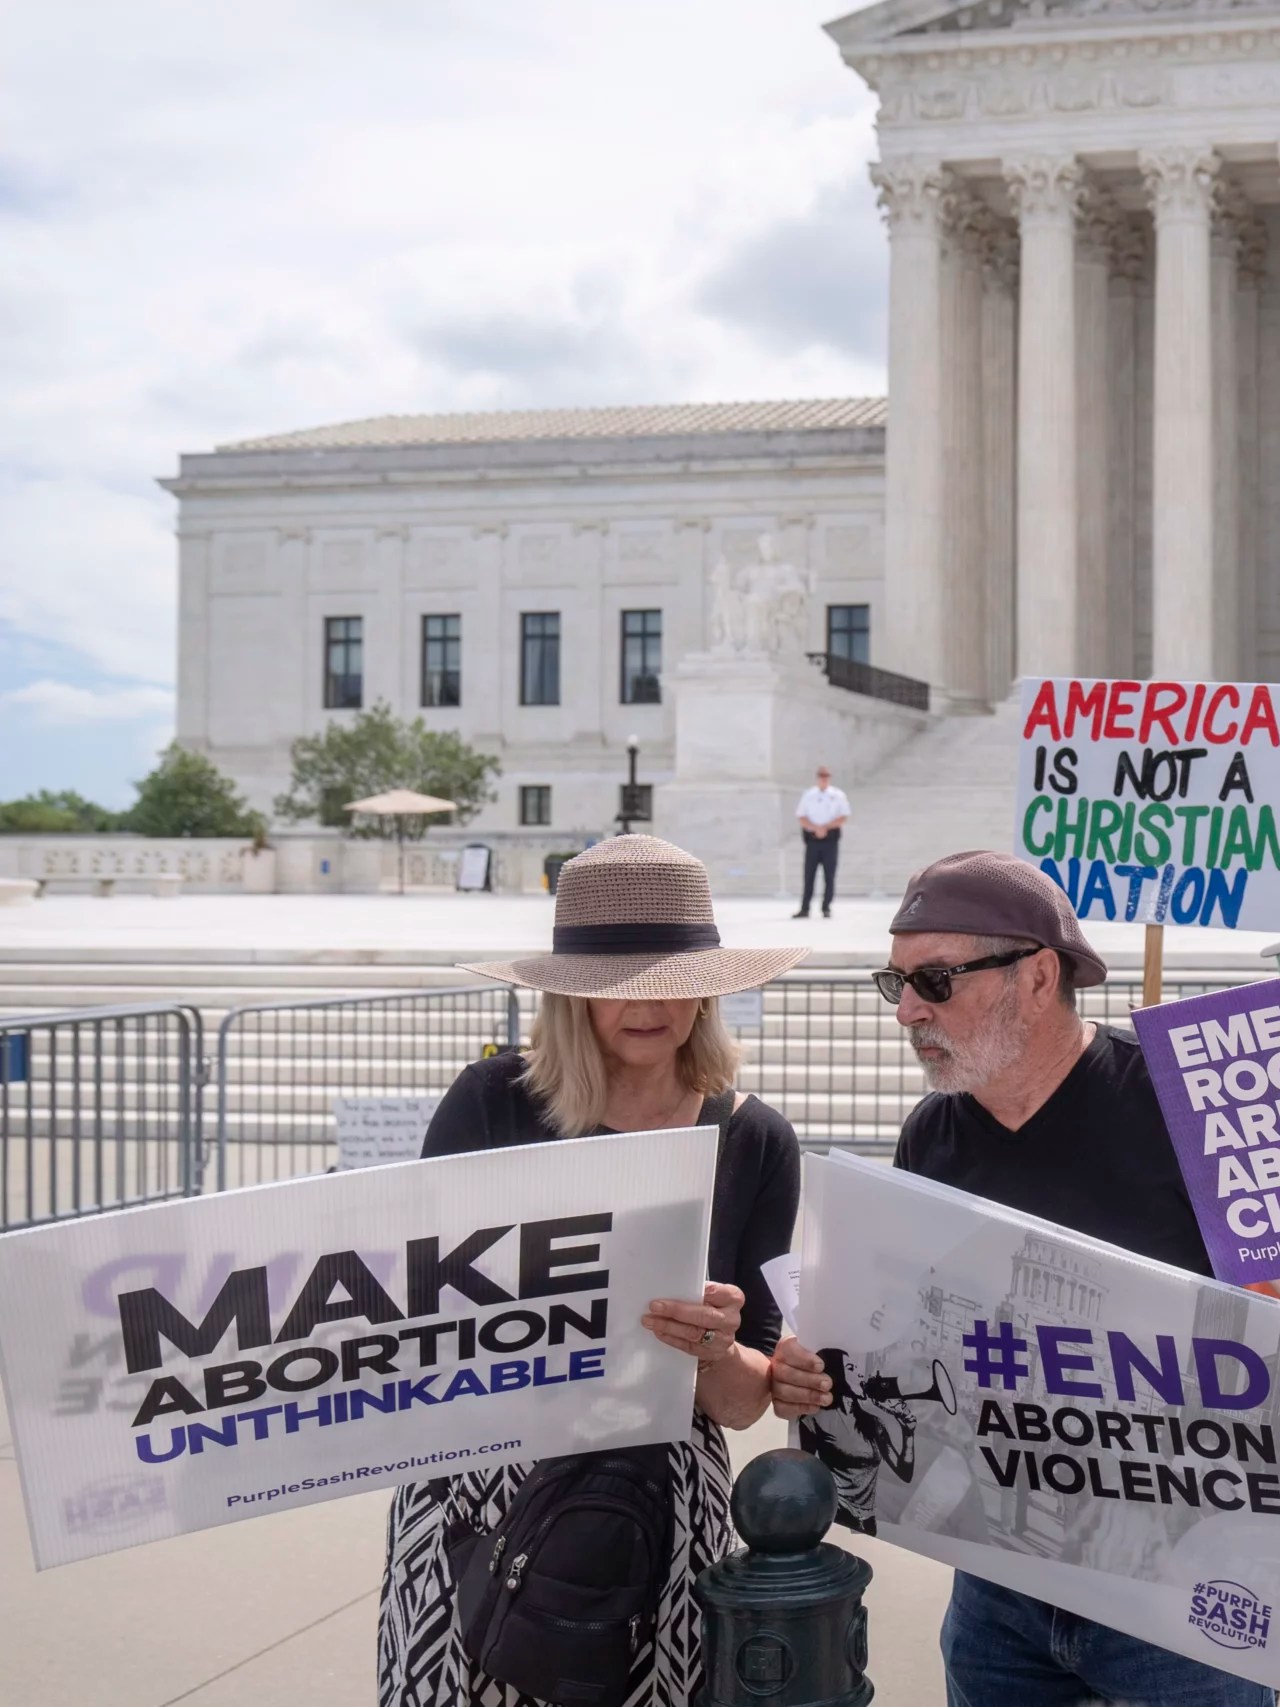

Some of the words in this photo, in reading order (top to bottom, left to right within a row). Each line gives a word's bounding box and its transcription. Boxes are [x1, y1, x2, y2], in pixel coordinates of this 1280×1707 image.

[1023, 680, 1280, 747] AMERICA
[1034, 746, 1079, 795] IS
[1114, 748, 1208, 802] NOT
[1219, 751, 1254, 804] A
[1040, 857, 1248, 929] NATION
[118, 1211, 613, 1374] MAKE
[130, 1298, 609, 1427] ABORTION
[962, 1320, 1271, 1410] #END
[136, 1347, 607, 1464] UNTHINKABLE
[976, 1400, 1278, 1464] ABORTION
[226, 1435, 523, 1508] PurpleSashRevolution.com
[1188, 1614, 1267, 1649] REVOLUTION
[1190, 1595, 1270, 1639] SASH
[1193, 1582, 1273, 1618] #PURPLE
